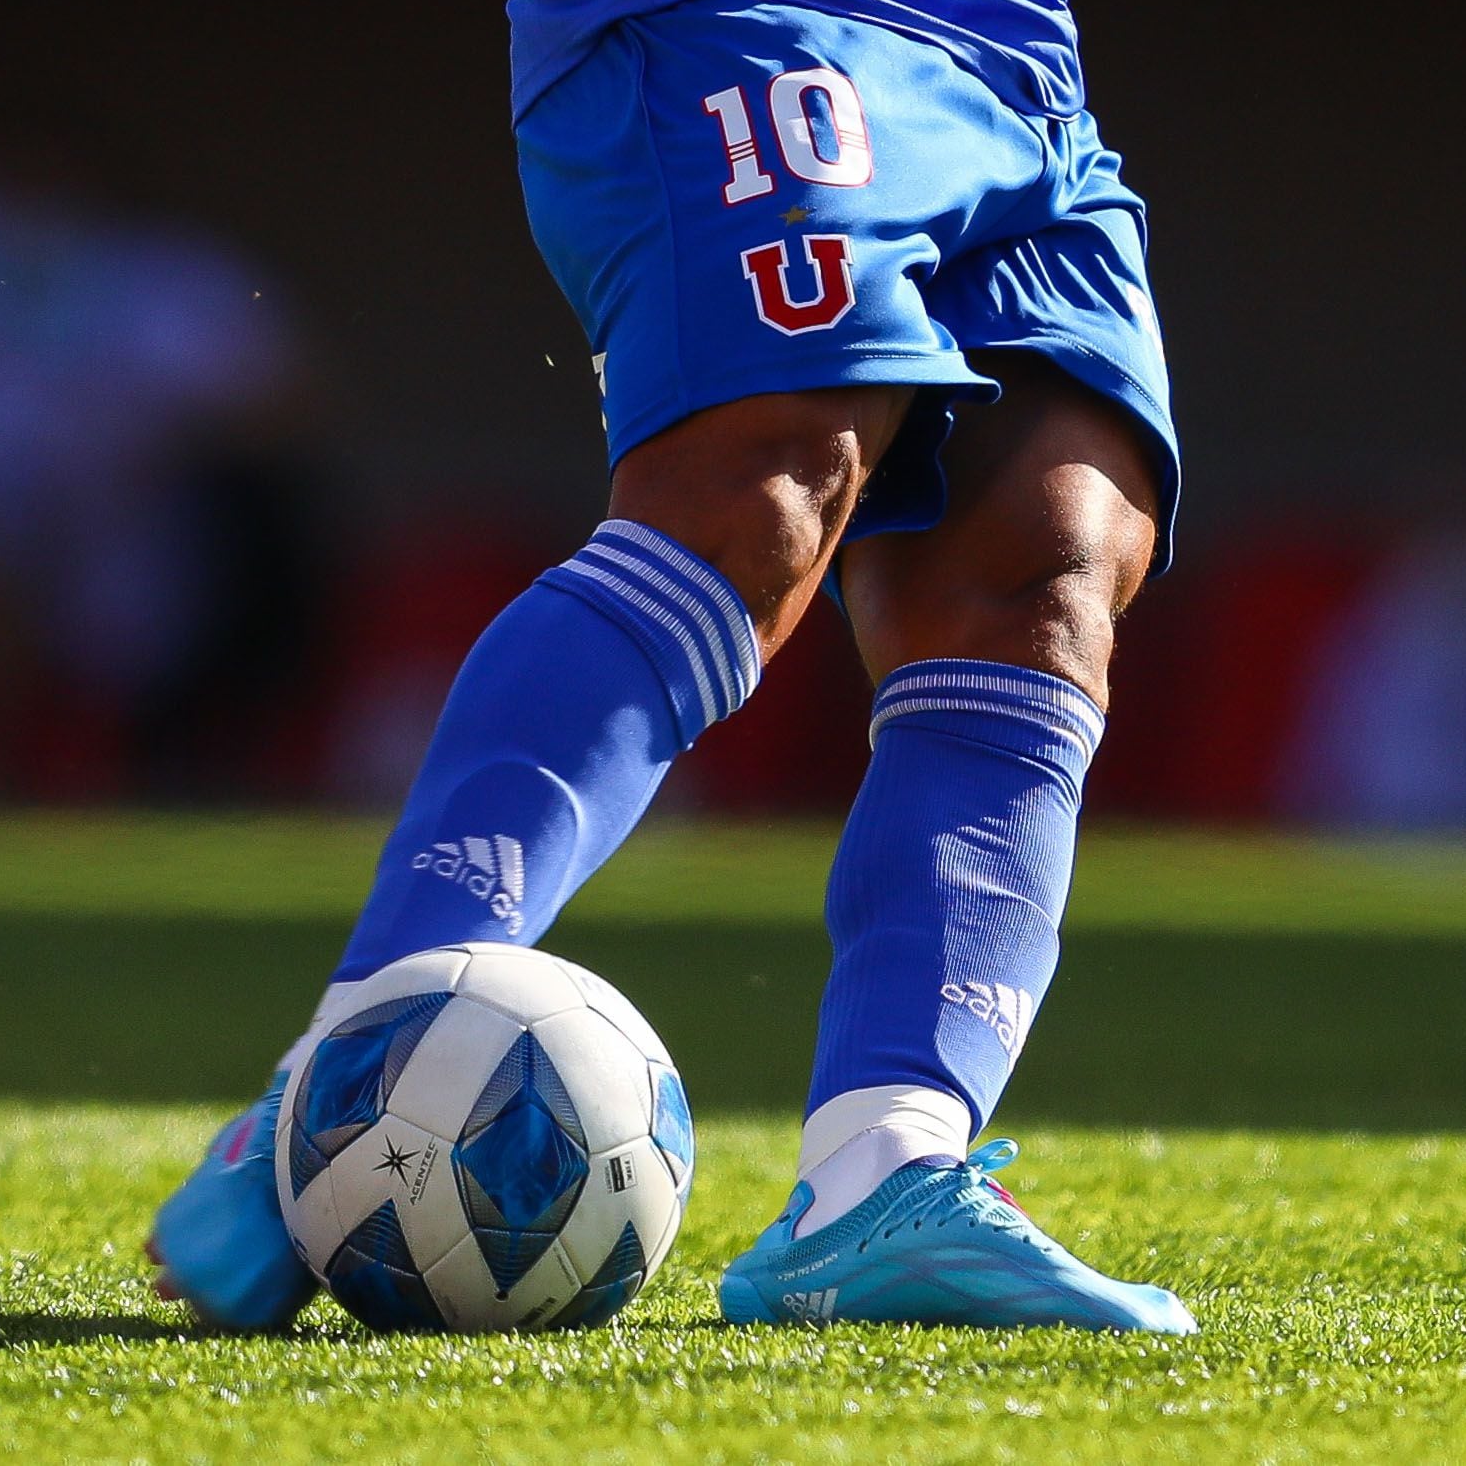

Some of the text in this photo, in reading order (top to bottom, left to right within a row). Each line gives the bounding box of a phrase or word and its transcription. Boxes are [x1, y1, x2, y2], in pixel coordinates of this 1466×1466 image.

[702, 66, 874, 206] 10
[740, 234, 857, 337] U
[413, 853, 523, 936] adidas
[410, 1141, 436, 1205] ACENTEC
